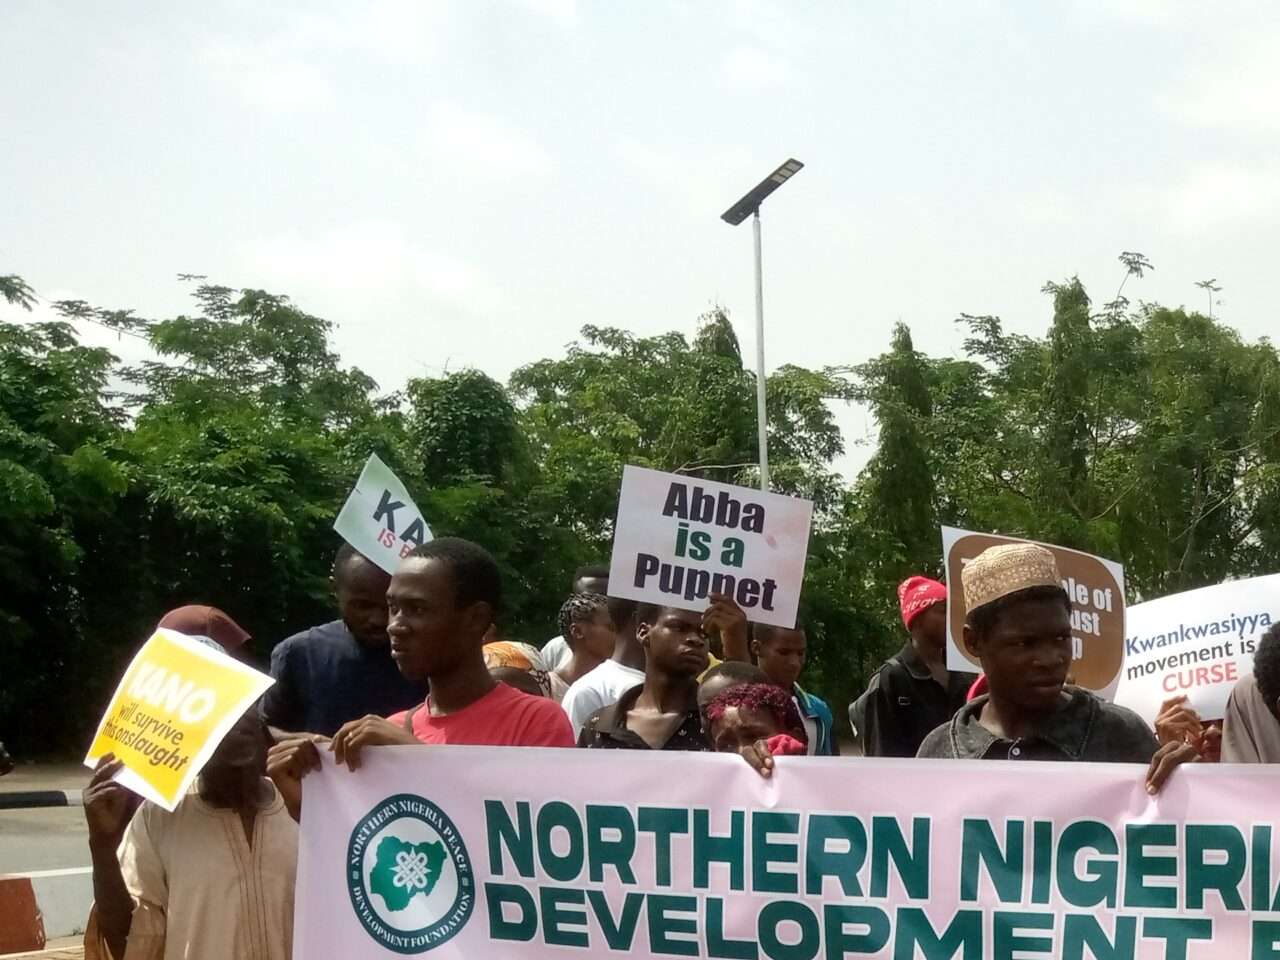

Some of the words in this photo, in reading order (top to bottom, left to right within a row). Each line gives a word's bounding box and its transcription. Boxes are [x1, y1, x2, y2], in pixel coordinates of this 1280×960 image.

[373, 488, 424, 545] KA
[662, 482, 765, 534] Abba
[377, 528, 396, 548] IS
[674, 522, 711, 561] is
[720, 537, 745, 568] a
[633, 553, 777, 611] Puppet
[1093, 588, 1112, 612] of
[1070, 610, 1100, 636] ust
[1125, 612, 1272, 656] Kwankwasiyya
[1127, 640, 1233, 680] movement
[1240, 636, 1255, 654] is
[1162, 661, 1238, 692] CURSE
[118, 702, 138, 722] will
[132, 711, 184, 746] survive
[115, 726, 189, 771] onslaught
[351, 803, 399, 866] NORTHERN
[400, 799, 444, 829] NIGERIA
[443, 825, 468, 872] PEACE
[484, 800, 929, 899] NORTHERN
[352, 886, 410, 947] DEVELOPMENT
[411, 892, 470, 947] FOUNDATION
